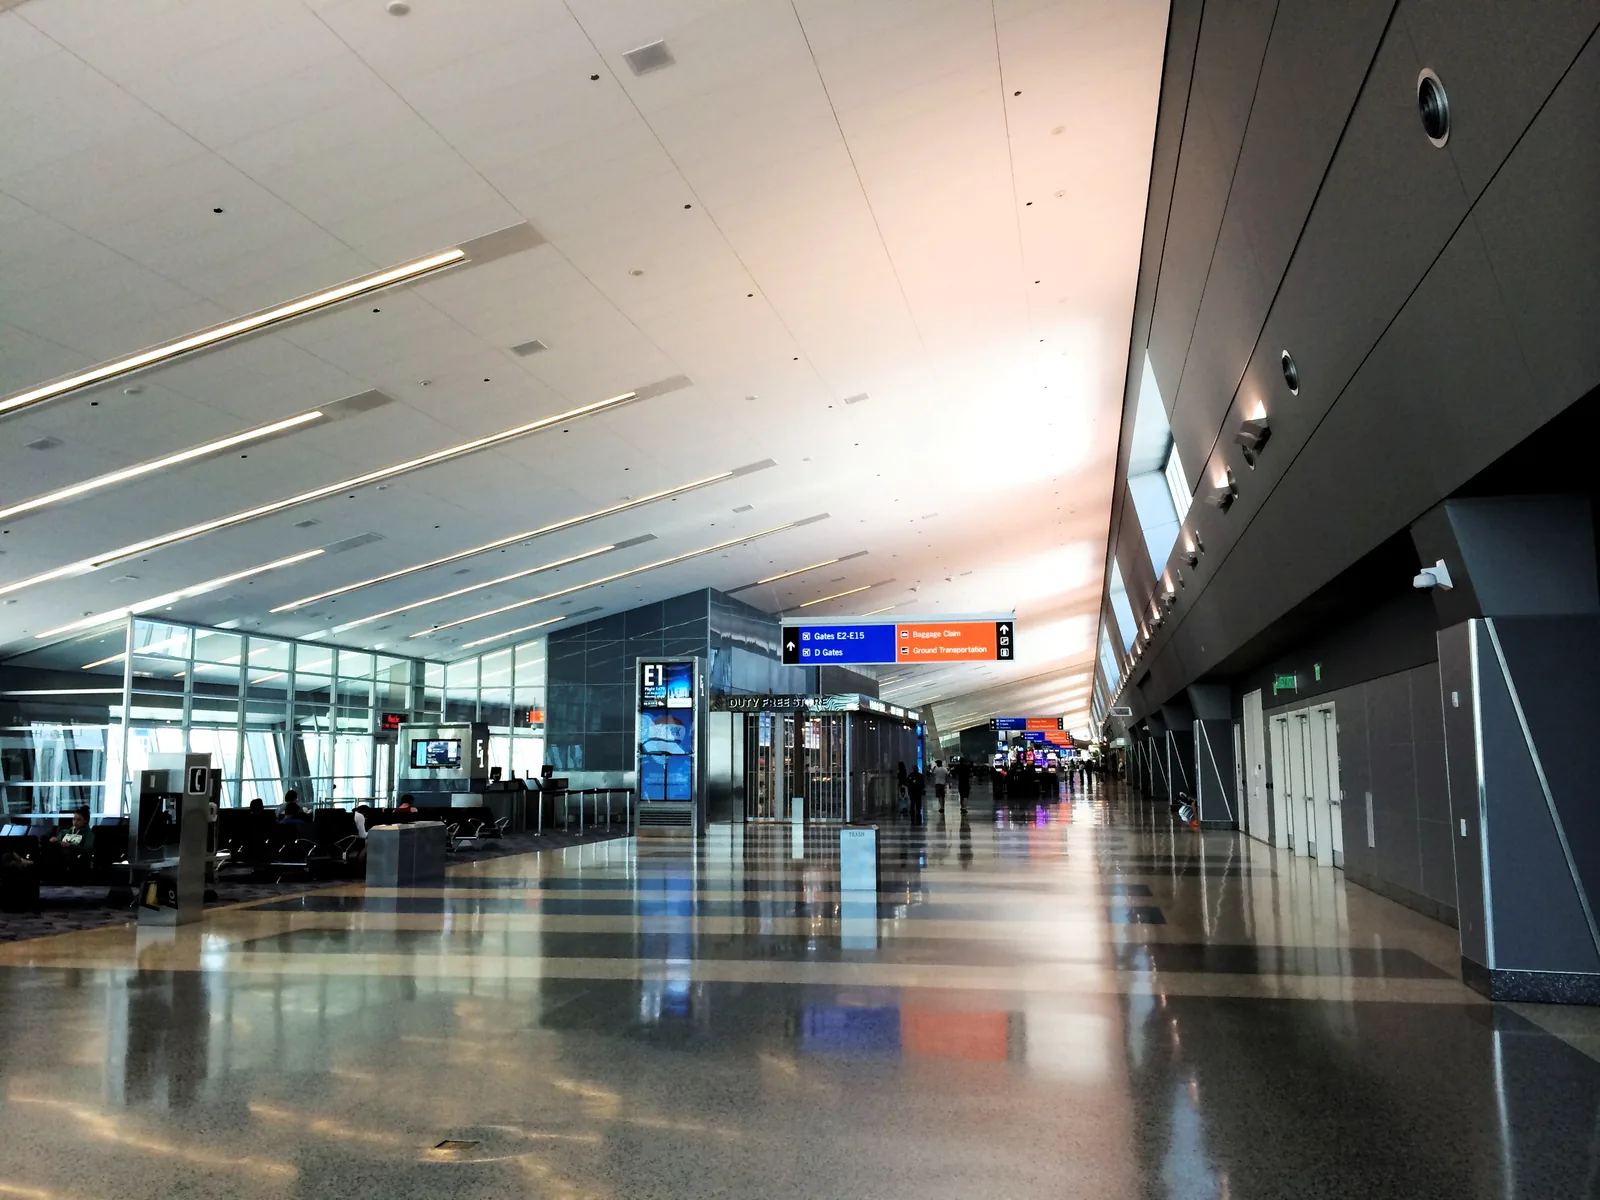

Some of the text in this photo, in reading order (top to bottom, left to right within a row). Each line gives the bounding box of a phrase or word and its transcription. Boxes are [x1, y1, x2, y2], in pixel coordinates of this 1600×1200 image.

[814, 631, 865, 641] Gates E2-E15
[912, 629, 961, 639] Baggage Claim
[814, 648, 843, 657] D Gates
[913, 645, 988, 655] Ground Transportation
[644, 664, 663, 686] E1
[729, 697, 828, 708] DUTY FREE STRE
